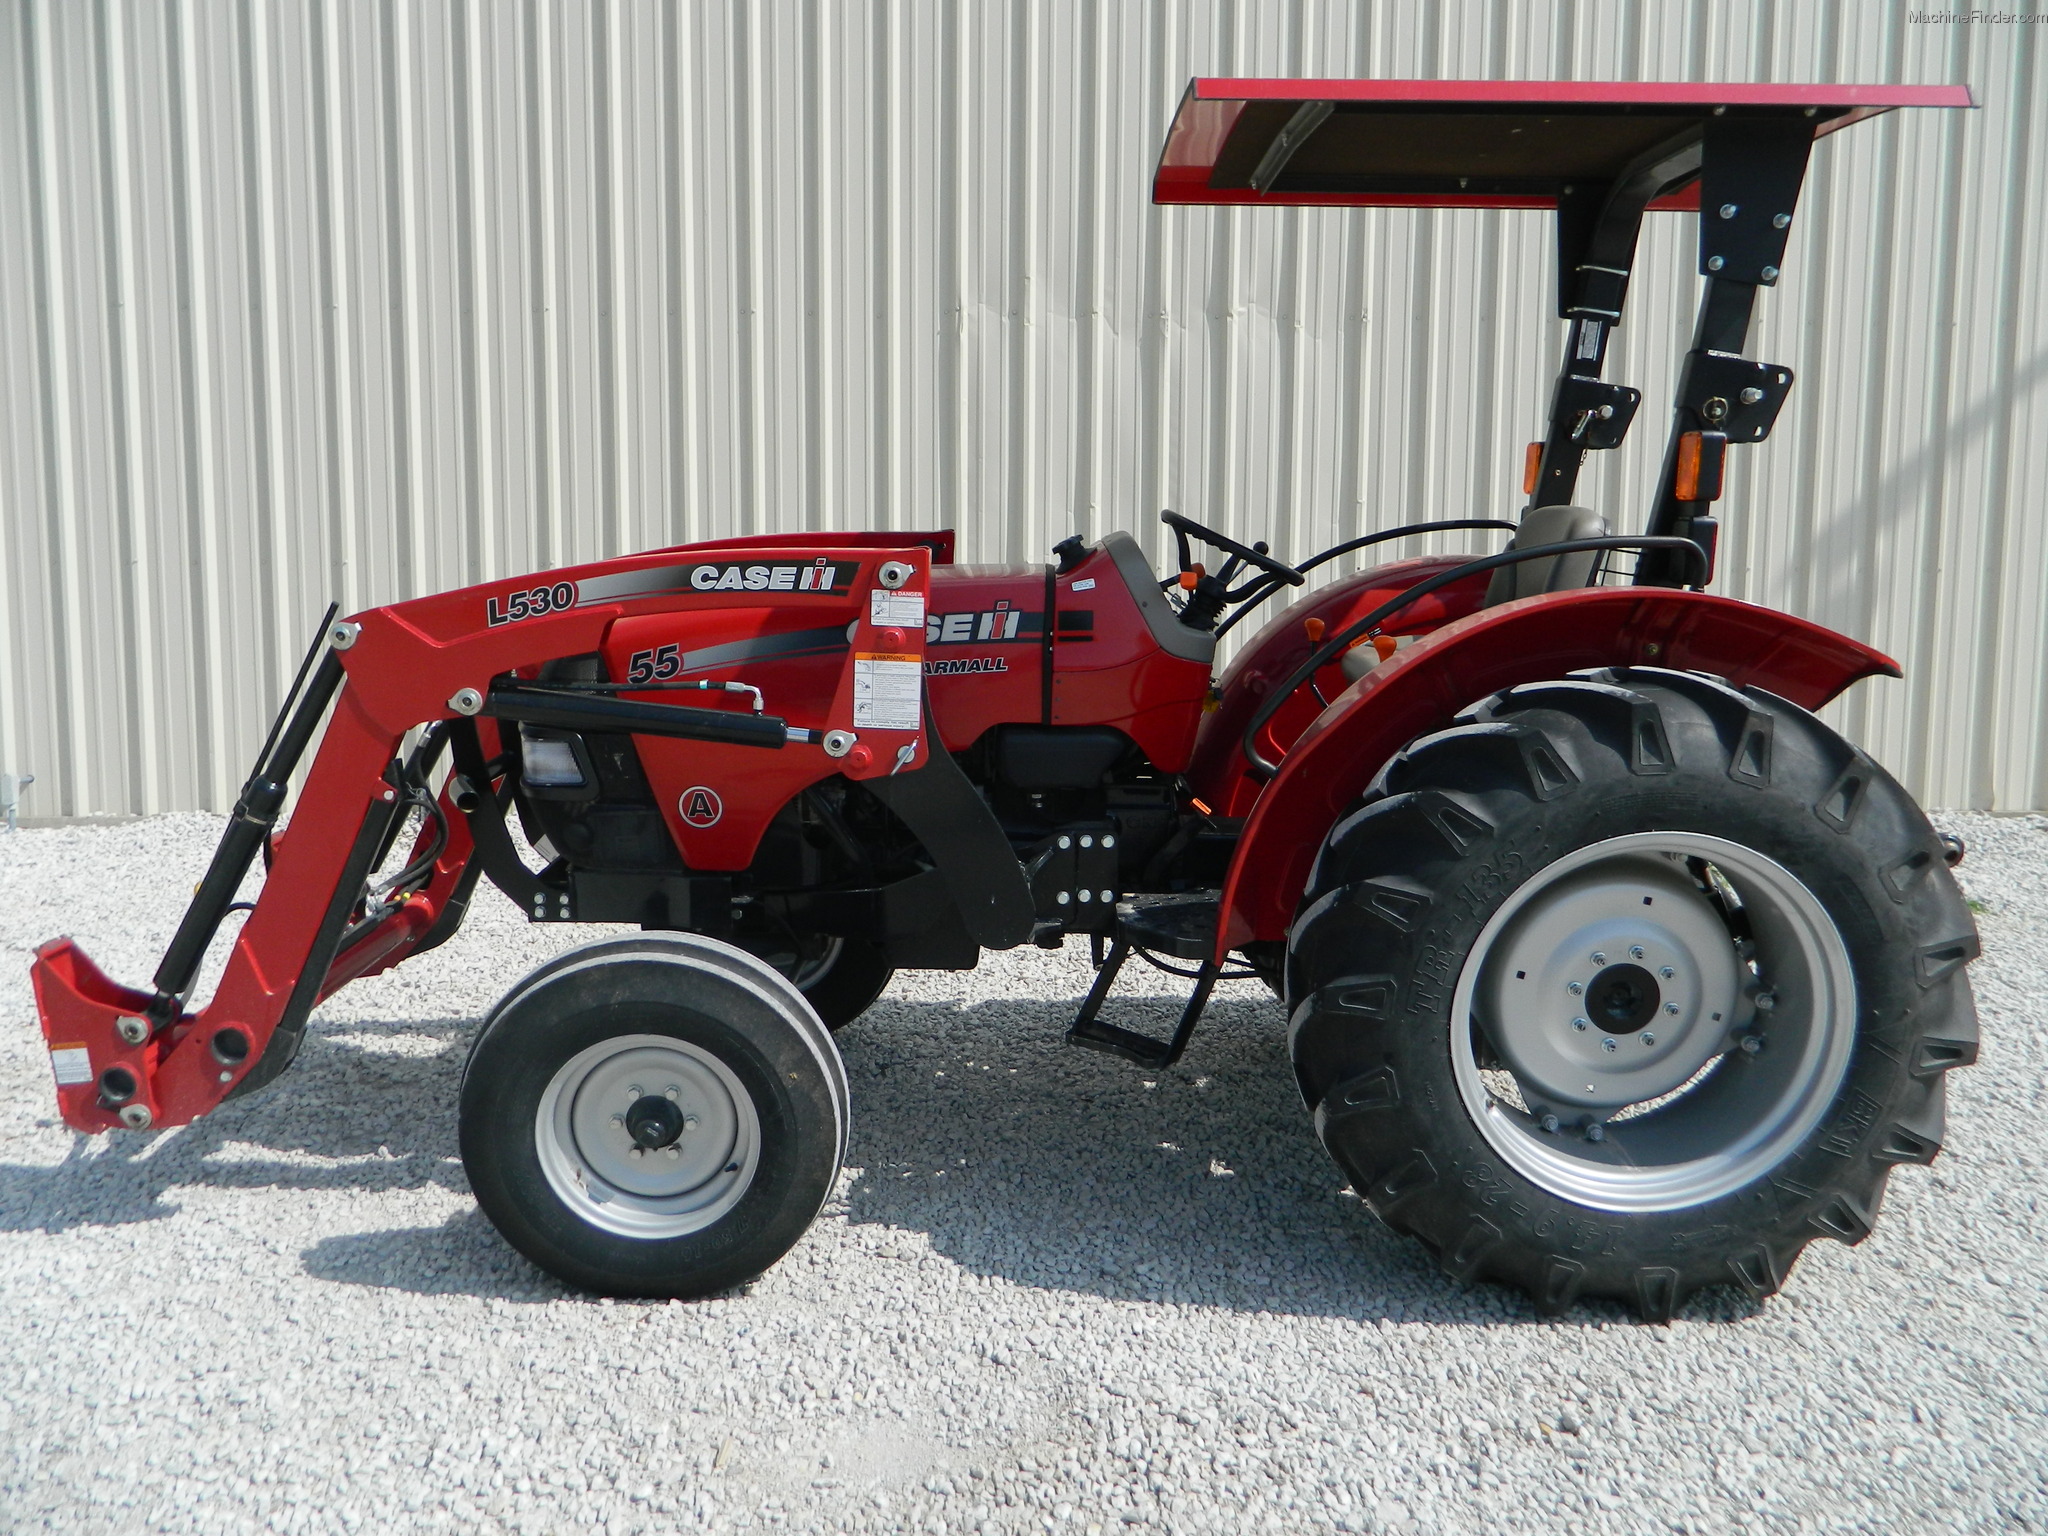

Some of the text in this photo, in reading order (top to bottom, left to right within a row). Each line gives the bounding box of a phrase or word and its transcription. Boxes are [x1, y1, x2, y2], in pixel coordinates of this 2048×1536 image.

[690, 565, 798, 591] CASE
[487, 581, 576, 628] L530
[627, 642, 681, 685] 55
[924, 657, 1009, 676] ARMALL
[687, 791, 716, 818] A
